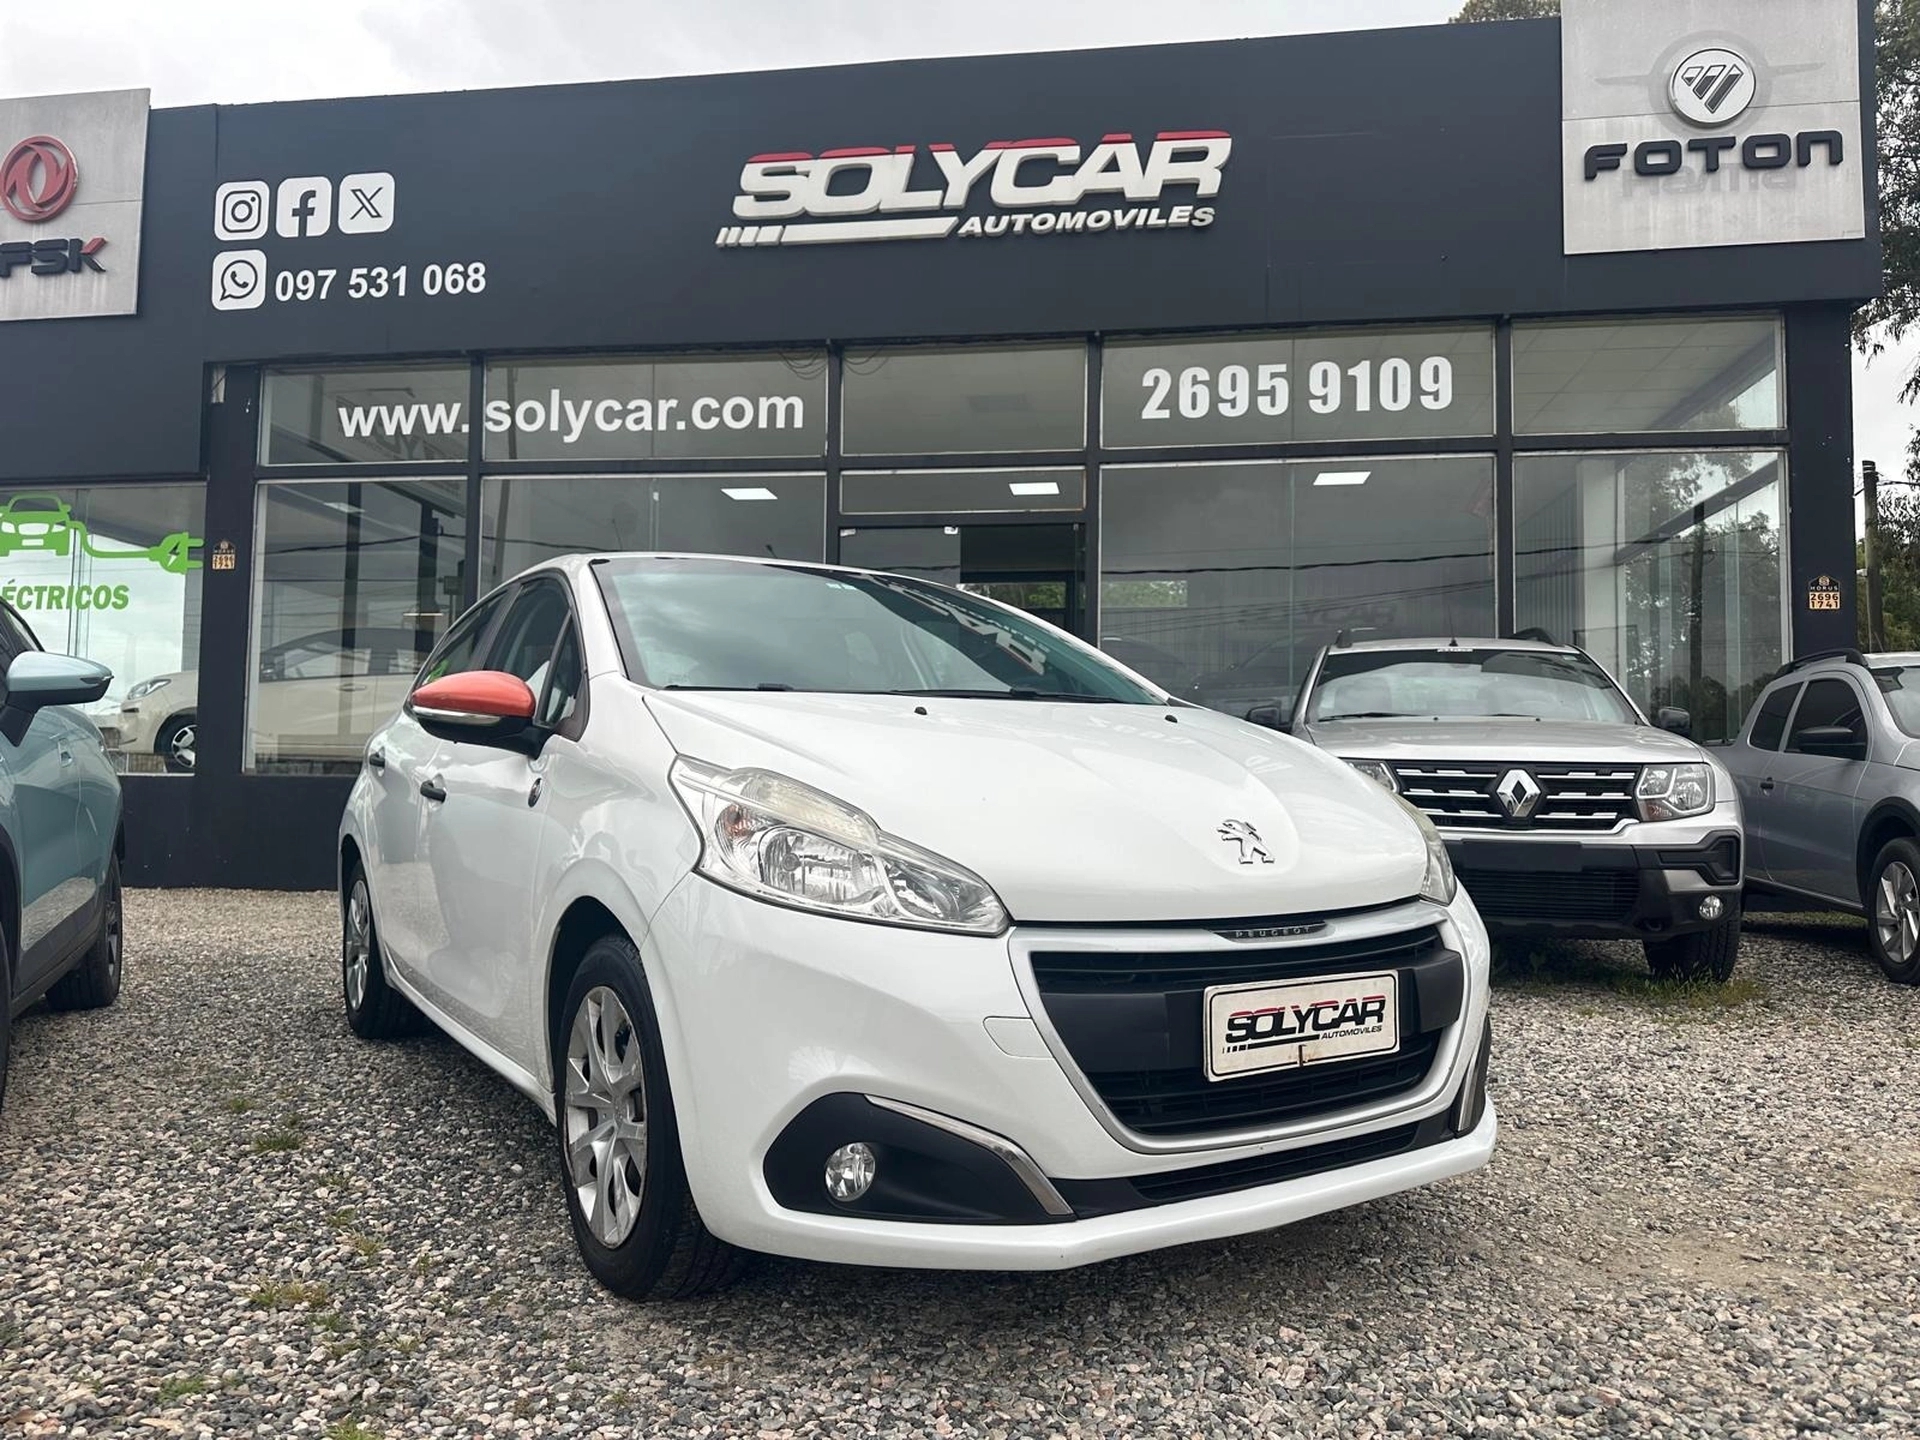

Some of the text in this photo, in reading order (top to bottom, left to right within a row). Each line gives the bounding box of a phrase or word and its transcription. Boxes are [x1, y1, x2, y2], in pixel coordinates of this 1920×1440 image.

[1584, 130, 1843, 181] FOTON
[732, 130, 1232, 219] SOLYCAR
[957, 205, 1215, 238] AUTOMOVILES
[275, 262, 486, 301] 097 531 068
[1141, 356, 1453, 420] 2695 9109
[1810, 593, 1839, 601] 2696
[1811, 600, 1838, 608] 1741
[1235, 927, 1310, 938] PEUGEOT
[1225, 995, 1386, 1044] SOLYCAR
[1321, 1025, 1383, 1041] AUTOMOVILES
